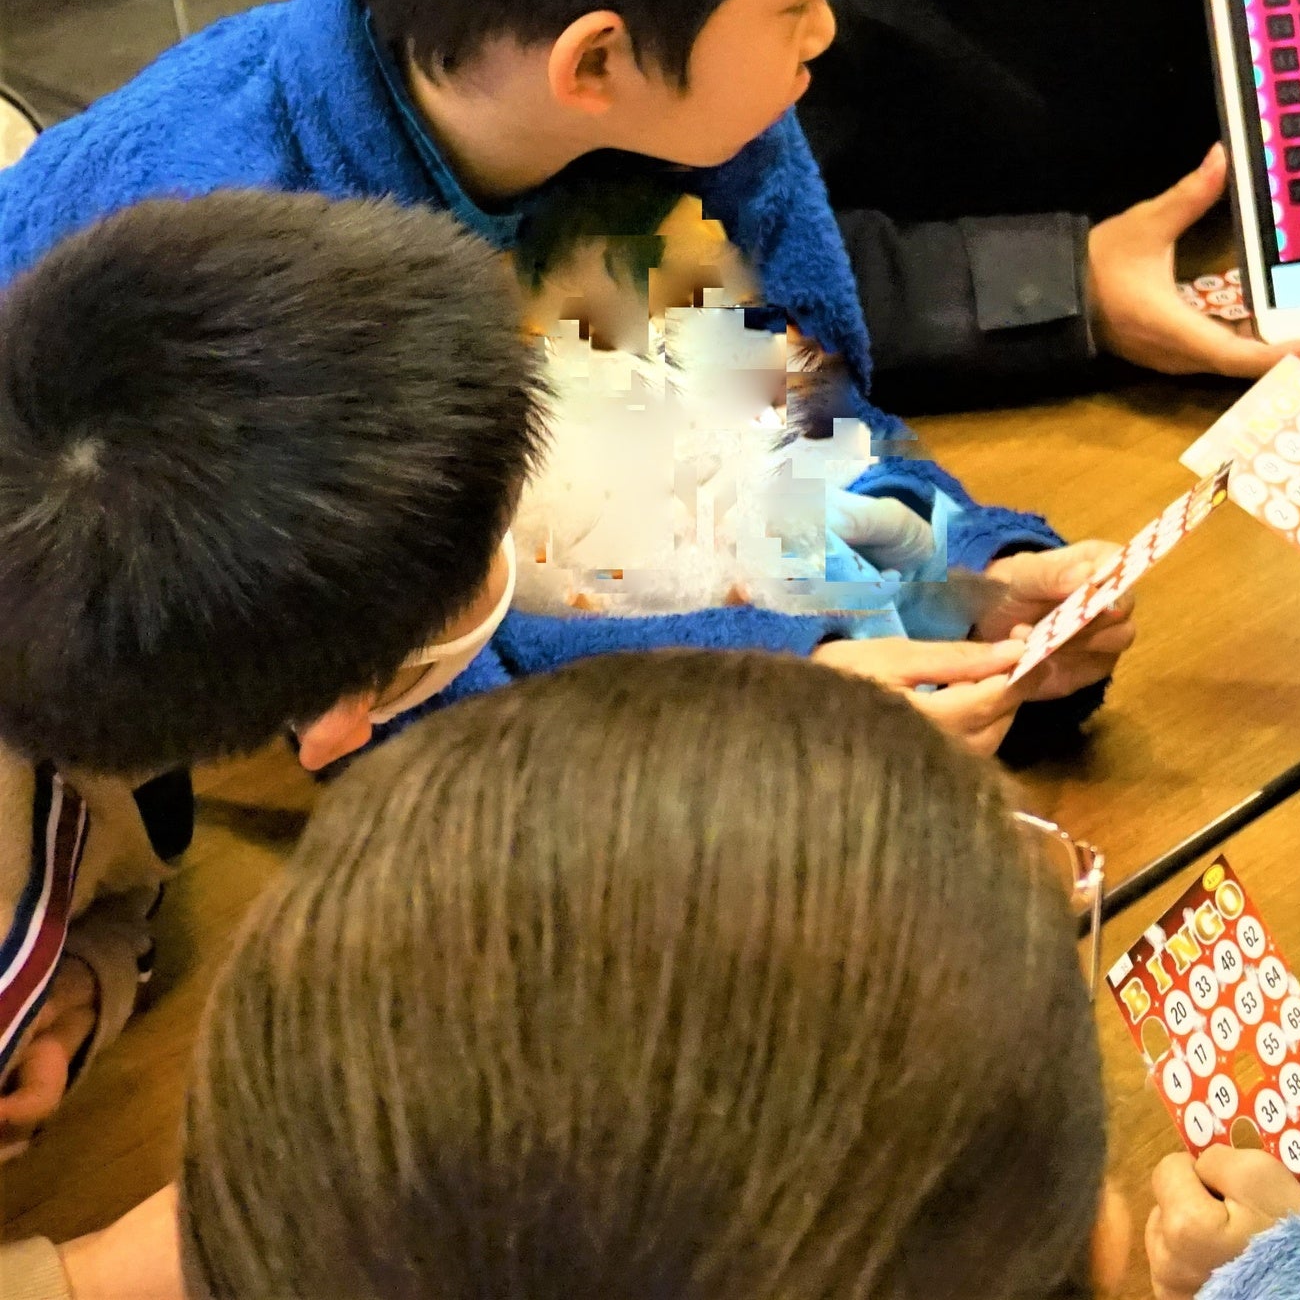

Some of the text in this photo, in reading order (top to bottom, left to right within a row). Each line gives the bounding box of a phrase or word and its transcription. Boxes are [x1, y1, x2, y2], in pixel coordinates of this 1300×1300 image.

[1275, 510, 1288, 521] 2
[1243, 926, 1259, 947] 62
[1119, 879, 1245, 1026] BINGO
[1222, 950, 1235, 970] 48
[1195, 976, 1211, 998] 33
[1266, 966, 1280, 988] 64
[1171, 1002, 1186, 1023] 20
[1241, 992, 1257, 1014] 53
[1218, 1018, 1232, 1039] 31
[1194, 1044, 1206, 1064] 17
[1263, 1033, 1279, 1055] 55
[1215, 1087, 1230, 1107] 19
[1262, 1100, 1278, 1122] 34
